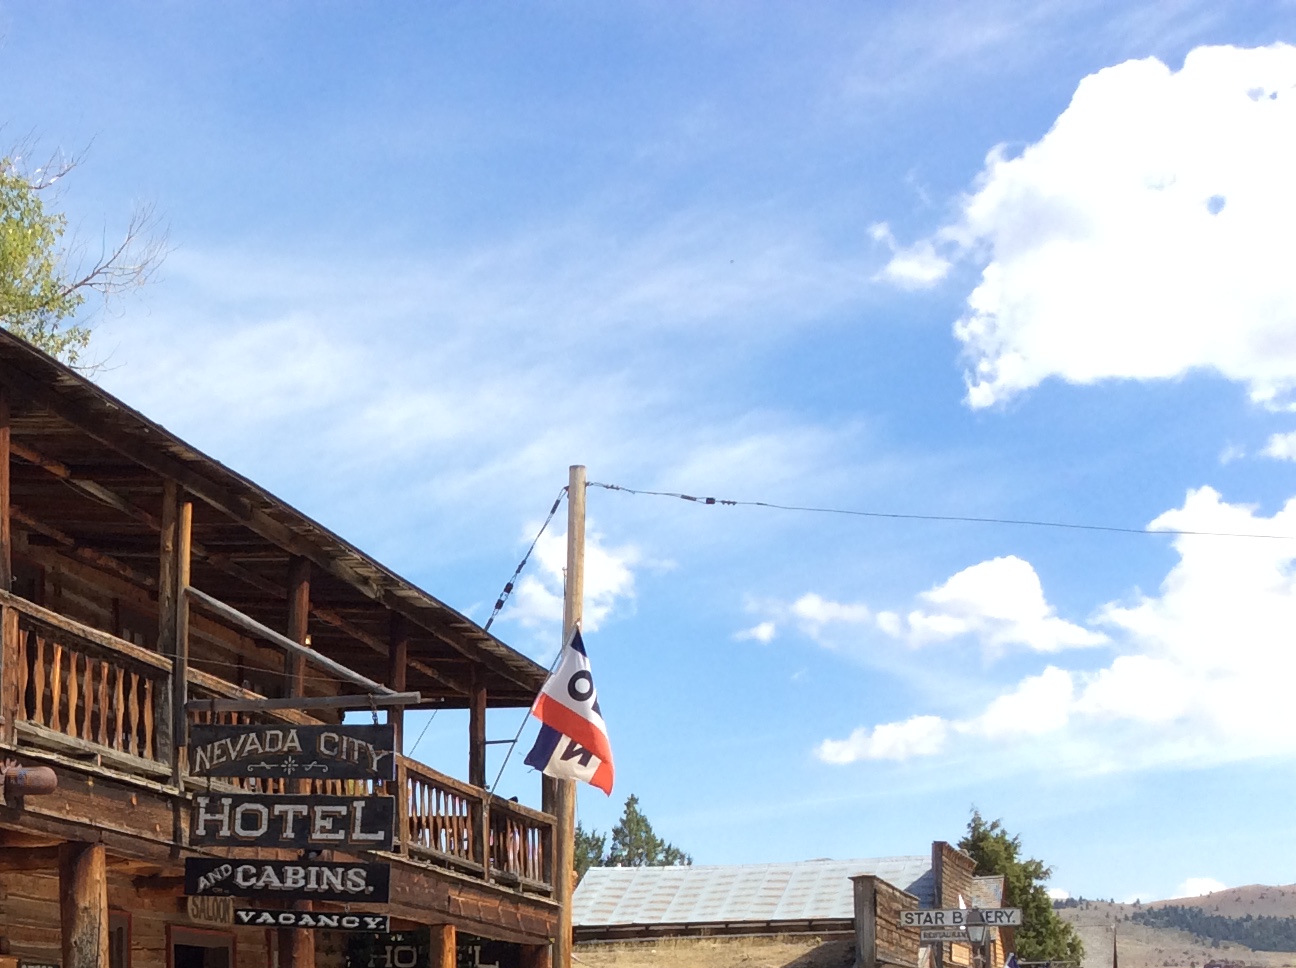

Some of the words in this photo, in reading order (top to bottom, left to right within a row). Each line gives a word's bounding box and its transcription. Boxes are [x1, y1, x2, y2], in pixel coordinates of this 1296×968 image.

[194, 728, 303, 775] NEVADA
[319, 731, 391, 773] CITY
[195, 796, 385, 843] HOTEL
[197, 863, 232, 893] AND
[233, 864, 375, 894] CABINS.
[191, 896, 231, 924] SALOON
[236, 910, 386, 930] VACANCY.
[904, 912, 945, 925] STAR
[952, 910, 1016, 924] BERY.
